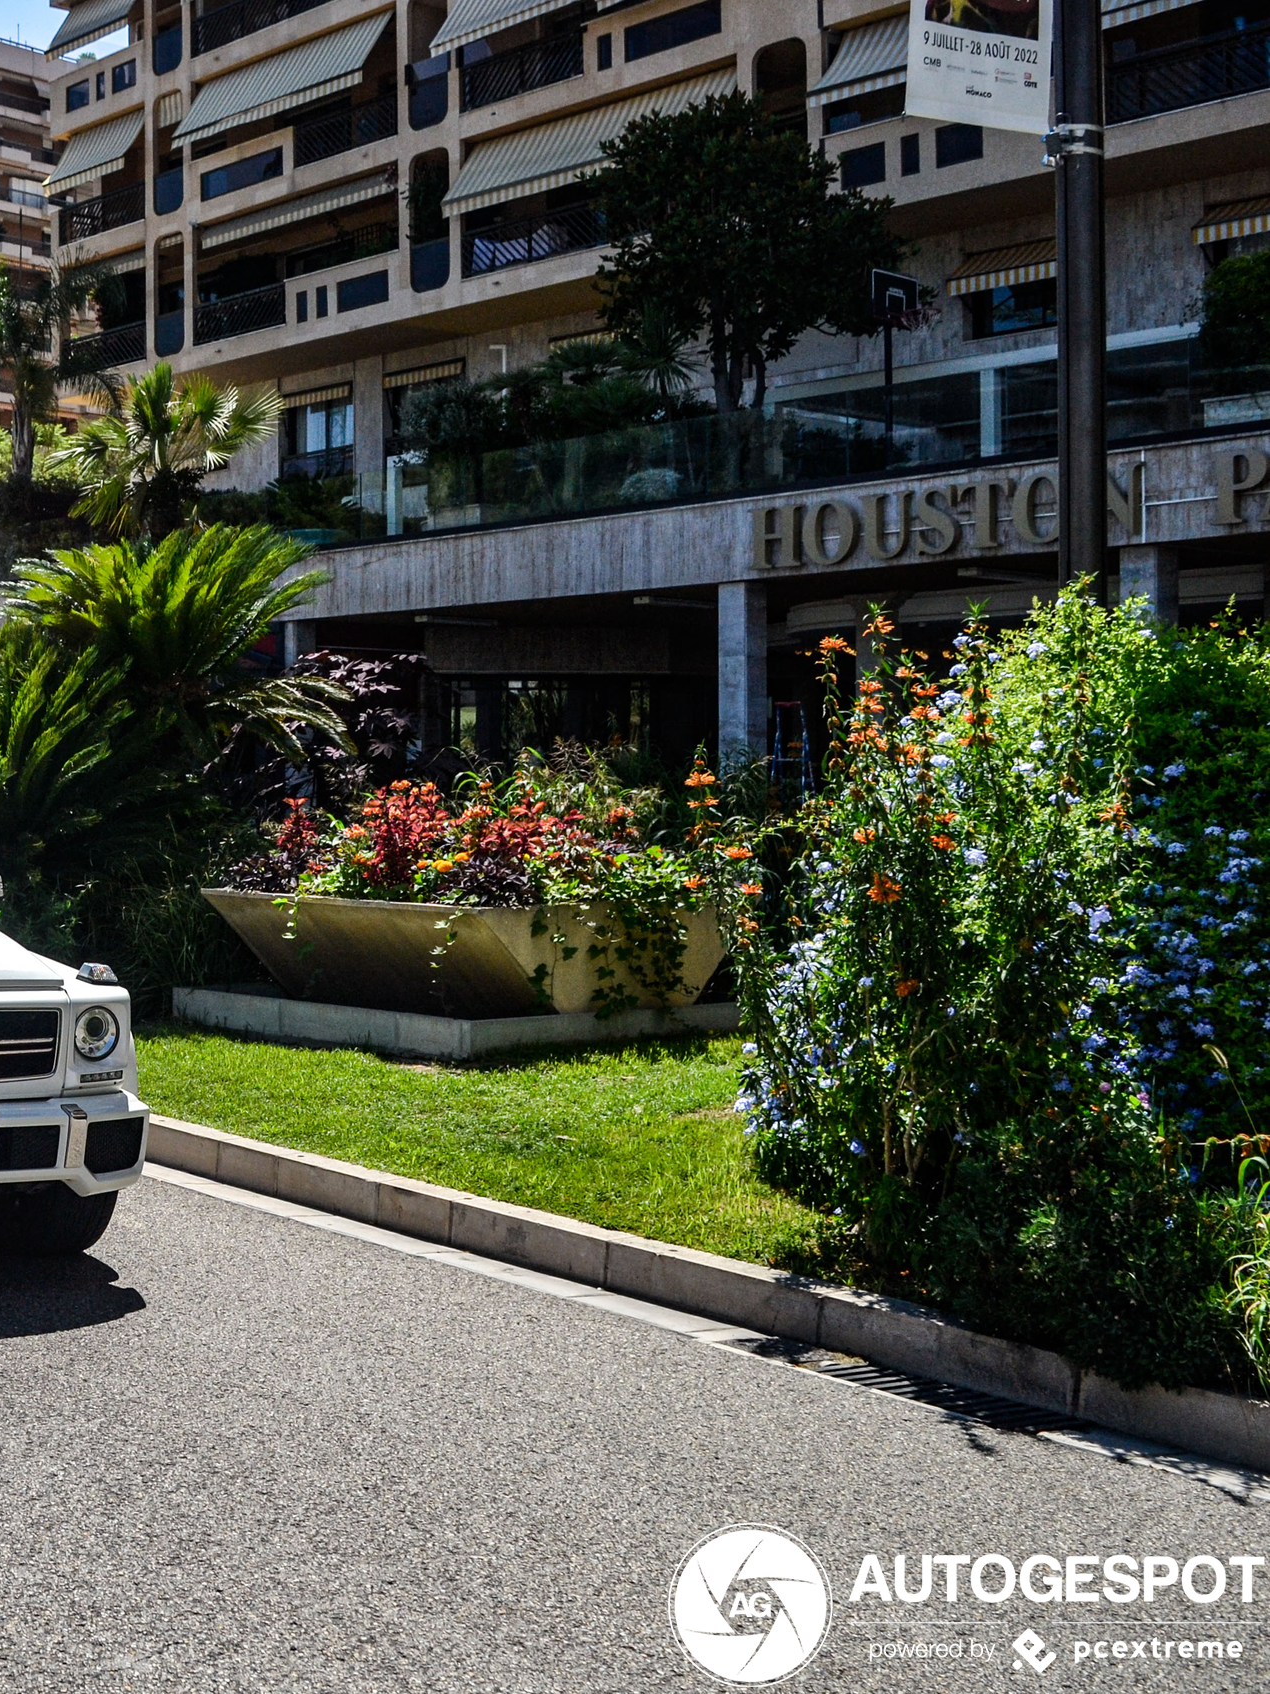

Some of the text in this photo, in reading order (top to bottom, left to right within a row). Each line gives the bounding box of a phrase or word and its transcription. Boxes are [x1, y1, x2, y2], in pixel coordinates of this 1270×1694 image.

[923, 31, 930, 45] 9
[984, 41, 1011, 60] AOÛT
[1014, 47, 1038, 65] 2022
[923, 56, 942, 68] CMB
[750, 448, 1270, 571] HOUSTON P
